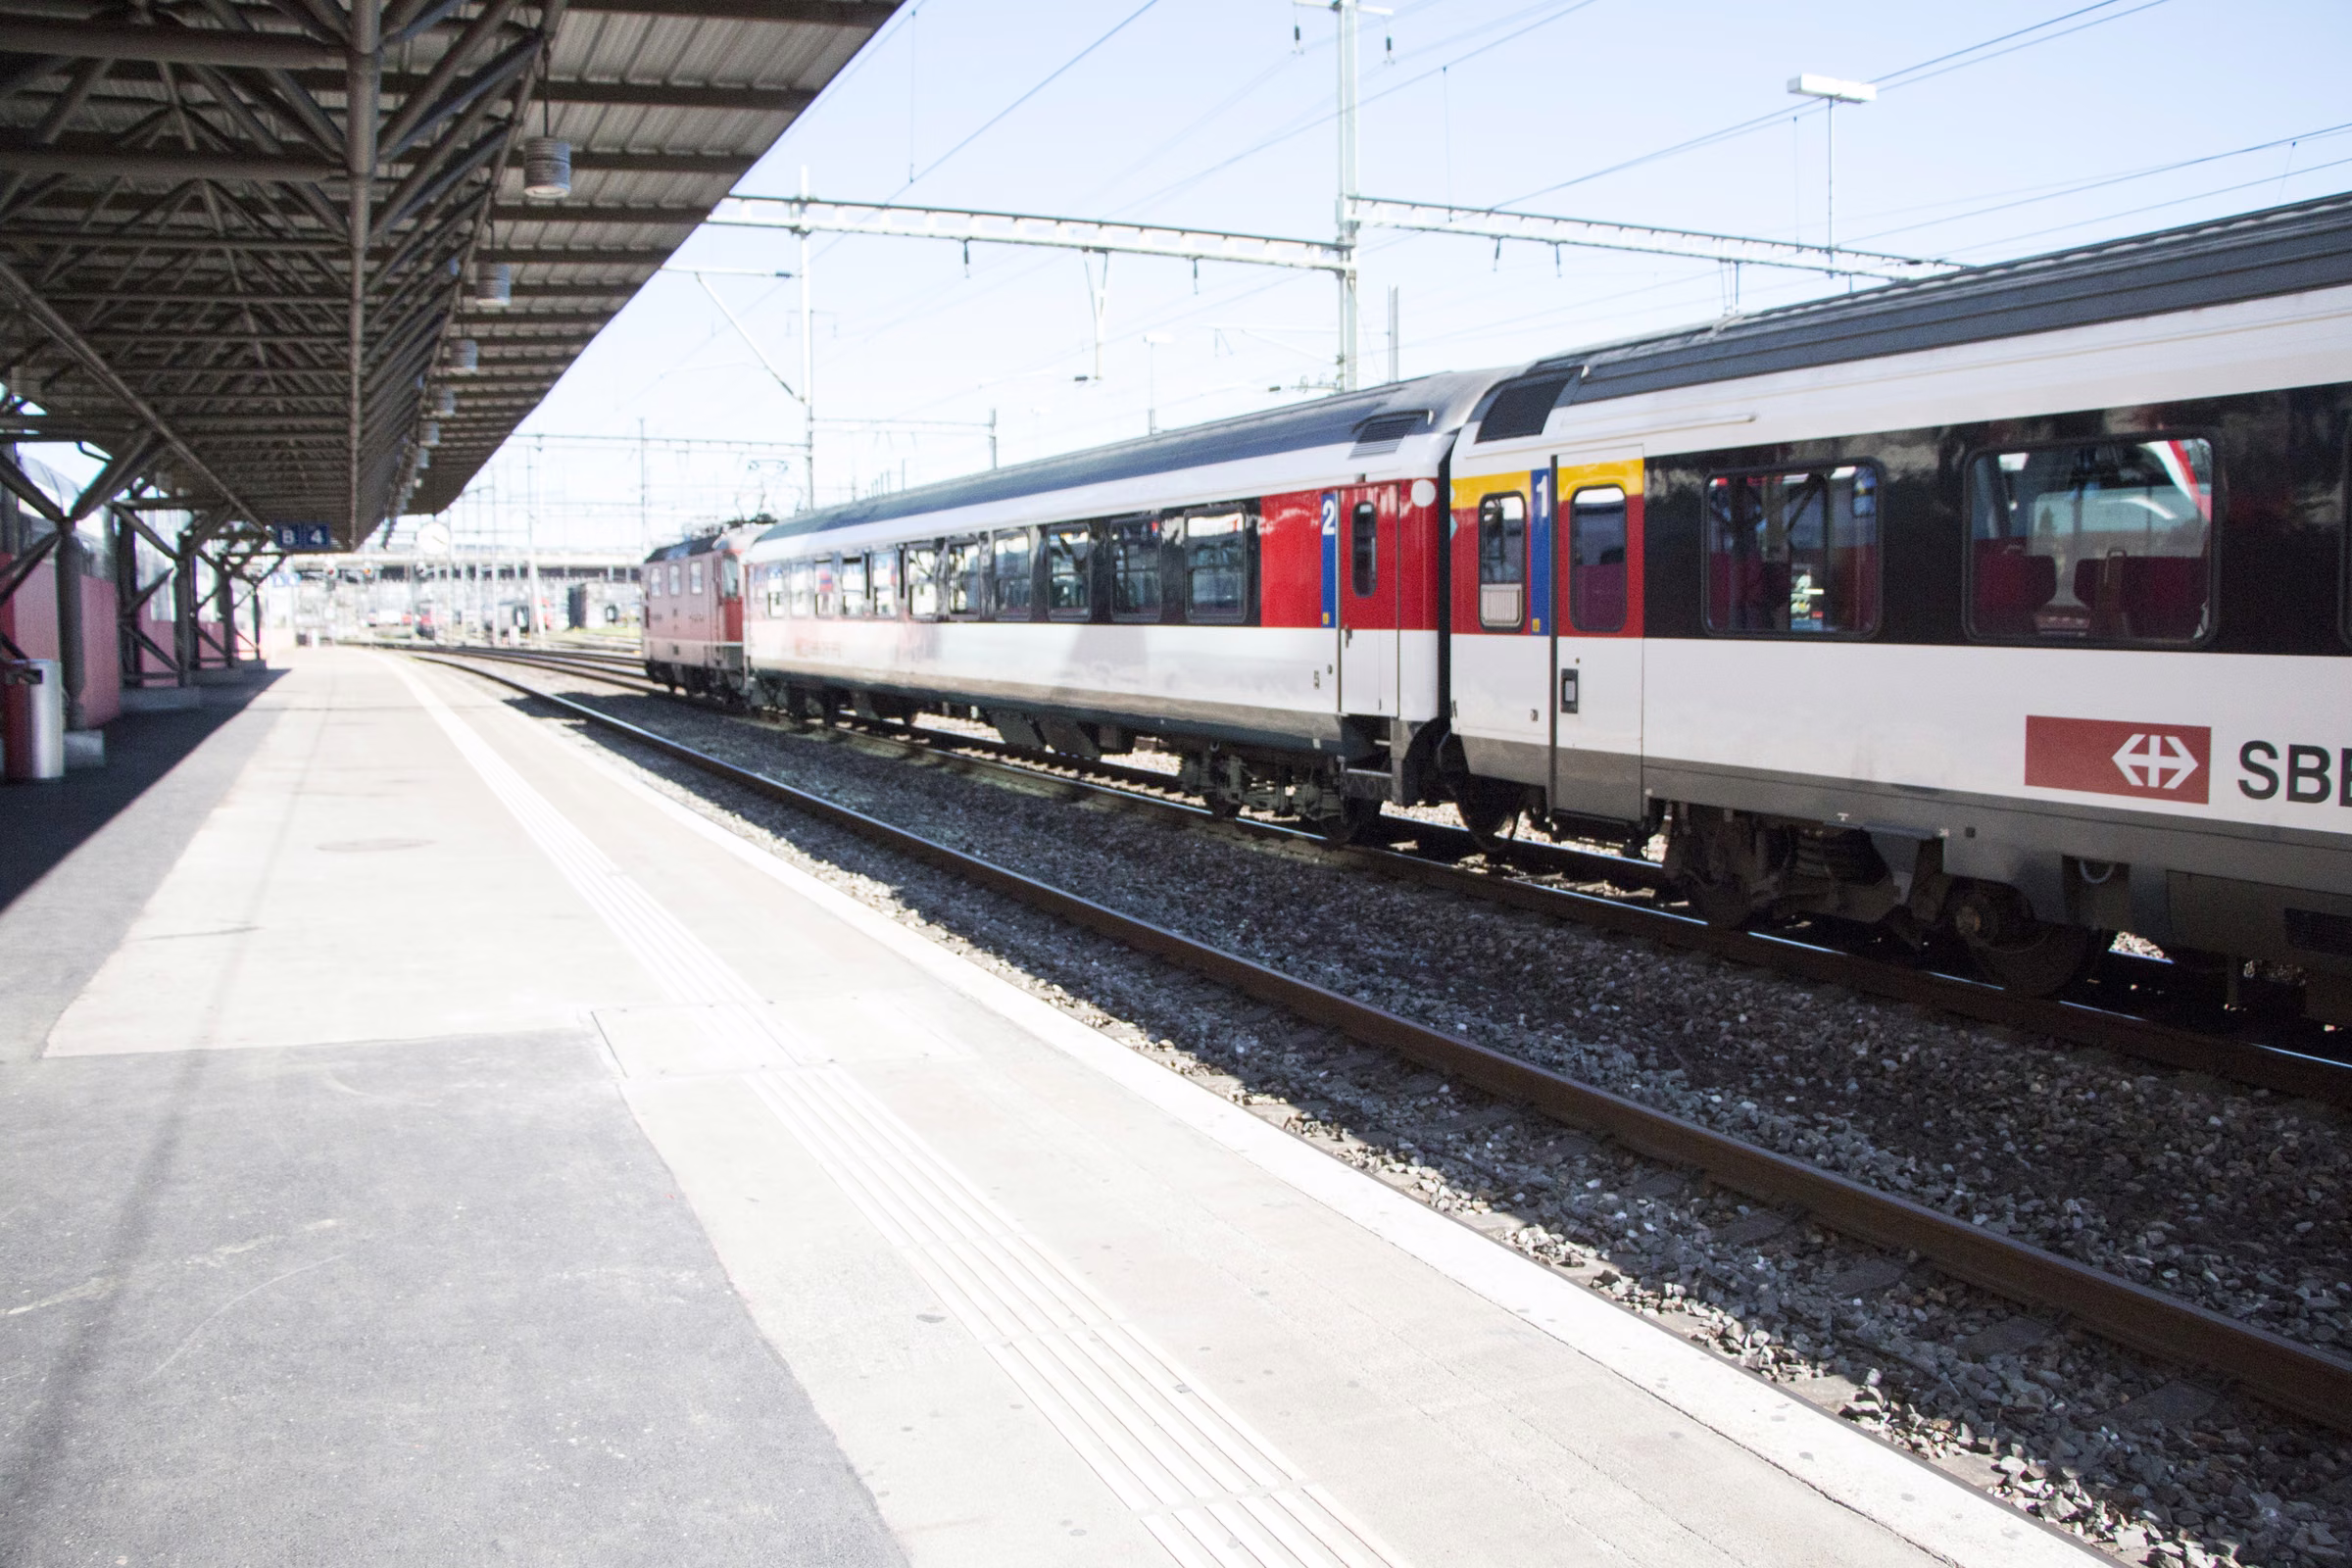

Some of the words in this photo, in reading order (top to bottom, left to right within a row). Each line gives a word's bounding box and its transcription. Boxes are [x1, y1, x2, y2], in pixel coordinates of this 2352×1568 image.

[1536, 475, 1547, 517] 1
[1322, 500, 1335, 535] 2
[282, 529, 295, 545] B
[311, 529, 324, 545] 4
[2237, 740, 2352, 808] SB
